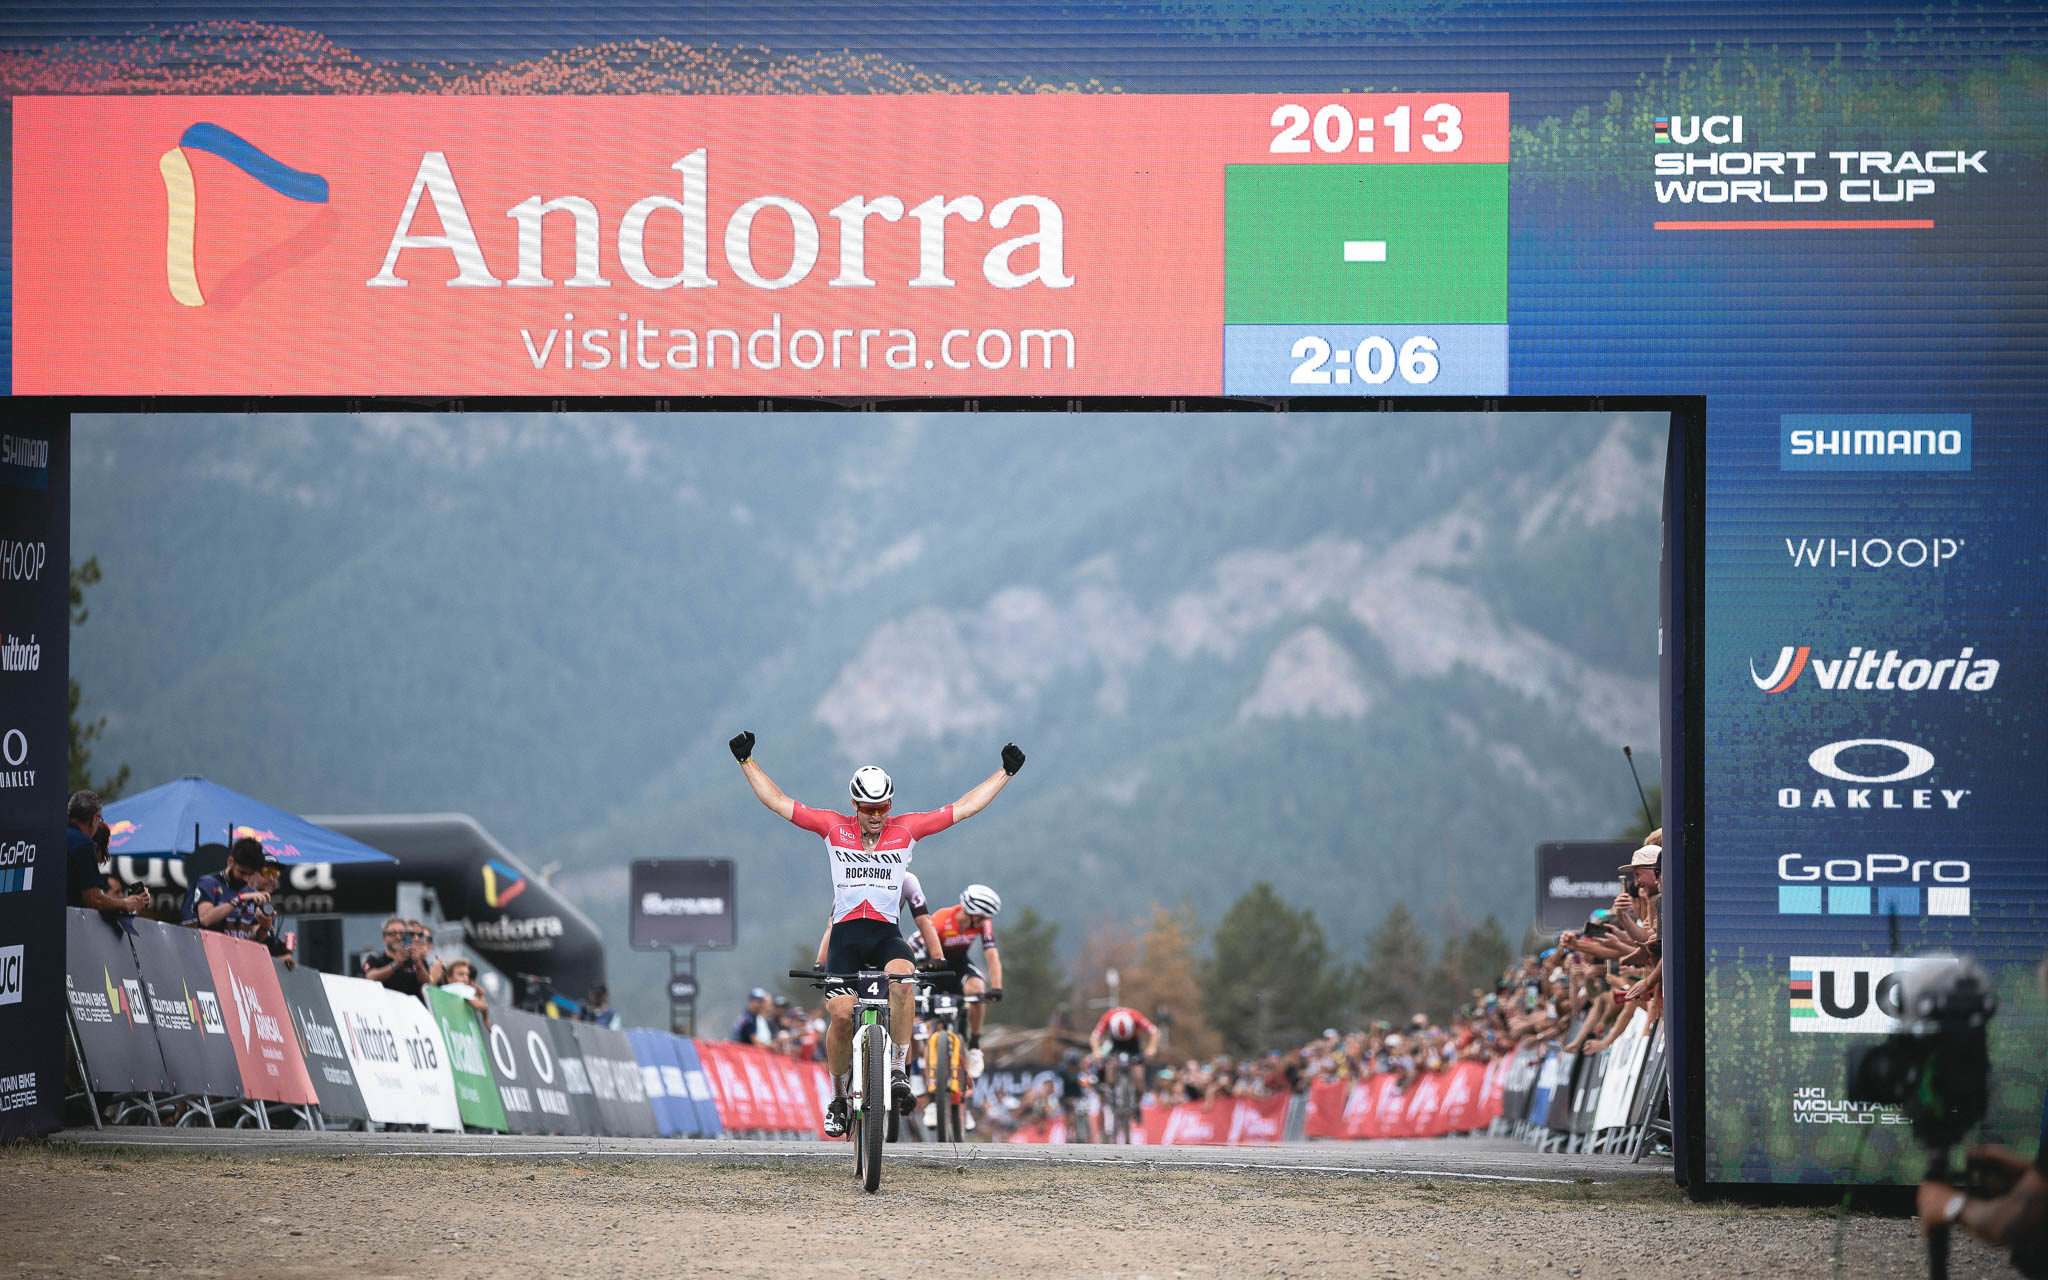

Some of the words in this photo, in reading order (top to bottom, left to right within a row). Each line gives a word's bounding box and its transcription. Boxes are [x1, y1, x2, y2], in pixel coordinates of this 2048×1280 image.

[1269, 103, 1463, 154] 20:13
[1670, 115, 1743, 145] UCI
[1654, 151, 1816, 176] SHORT
[1829, 150, 1988, 175] TRACK
[1654, 179, 1828, 204] WORLD
[1839, 178, 1936, 203] CUP
[366, 147, 1075, 290] Andorra
[521, 312, 1076, 371] visitandorra.com
[1289, 335, 1440, 385] 2:06
[2, 433, 49, 470] SHIMANO
[1789, 429, 1962, 456] SHIMANO
[1785, 538, 1958, 568] WHOOP
[1, 633, 41, 672] vittoria
[1811, 646, 2001, 691] vittoria
[1777, 787, 1966, 809] OAKLEY
[840, 828, 855, 840] UCI
[0, 840, 36, 866] GoPro
[835, 850, 902, 863] CANYON
[845, 867, 892, 880] ROCKSHOX
[1777, 852, 1971, 883] GoPro
[867, 981, 880, 996] 4
[354, 1012, 399, 1063] vittoria
[1797, 1087, 1825, 1098] UCI
[1793, 1112, 1875, 1124] WORLD
